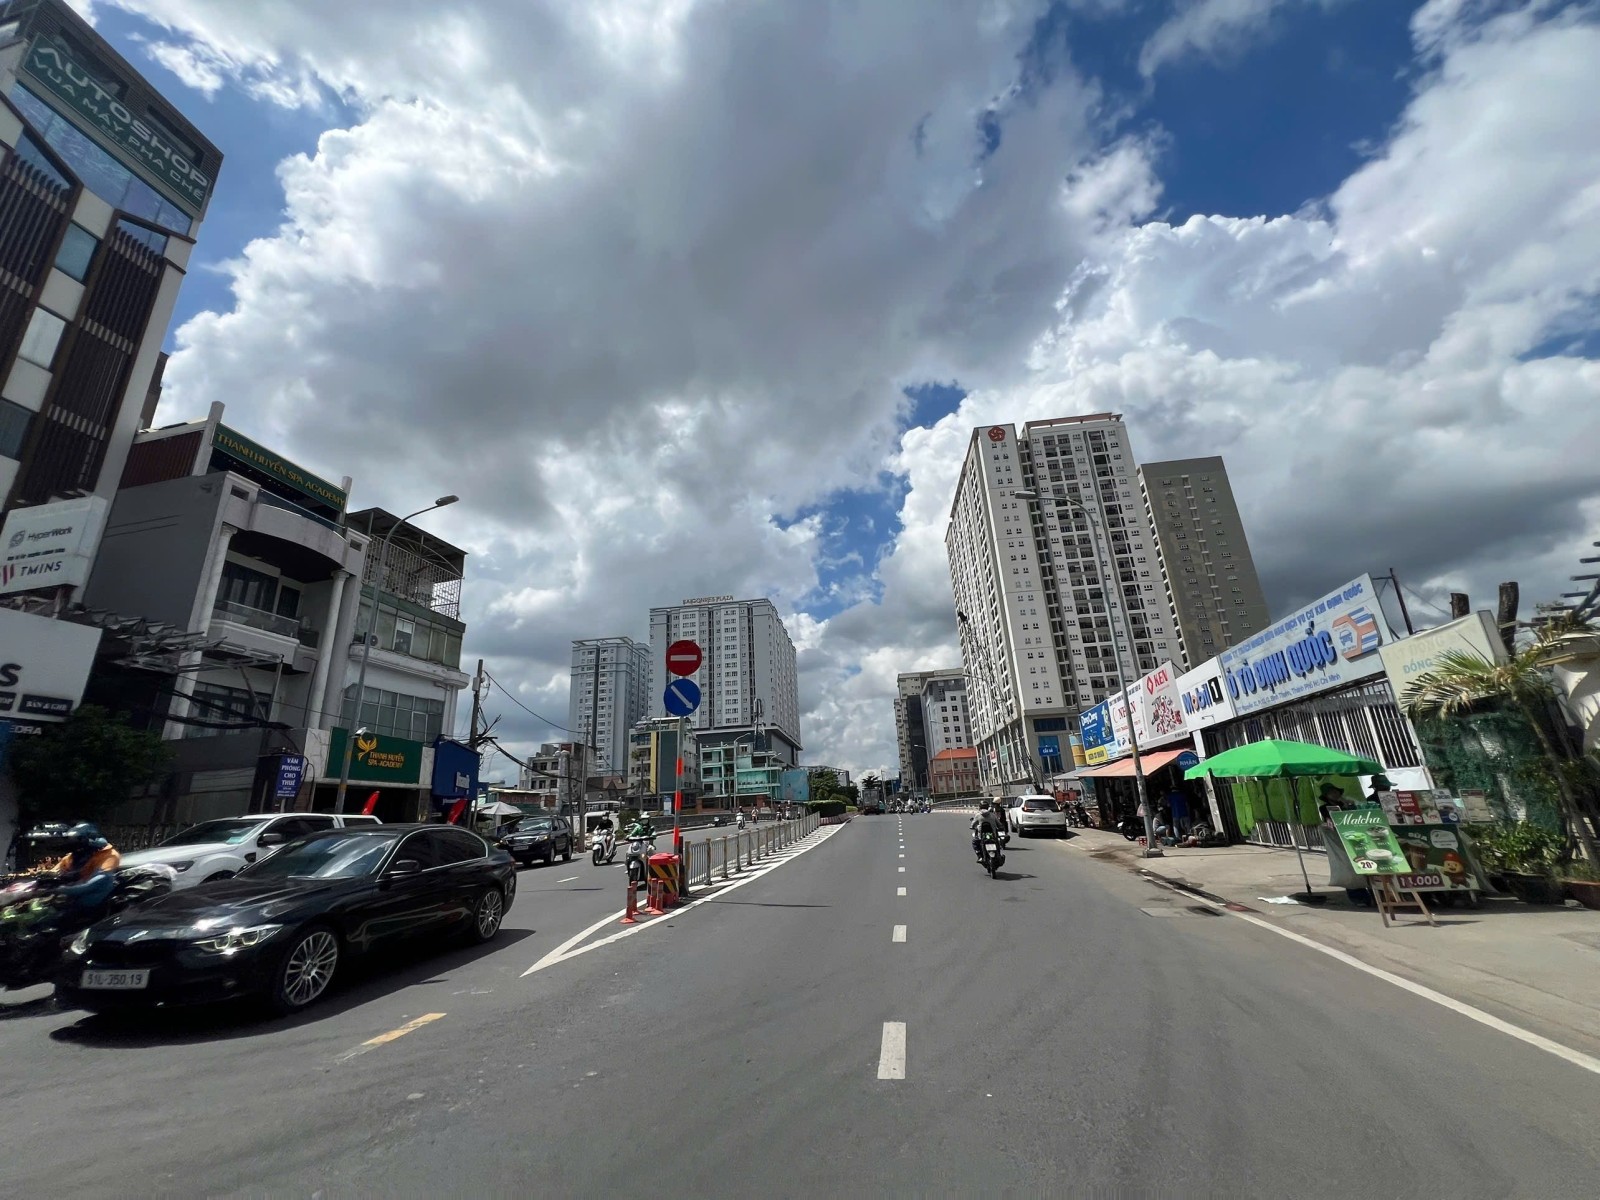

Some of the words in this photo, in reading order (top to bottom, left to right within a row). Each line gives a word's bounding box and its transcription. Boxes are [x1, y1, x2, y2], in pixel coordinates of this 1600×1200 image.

[34, 55, 75, 96] VUA
[129, 135, 165, 170] PHA
[37, 47, 208, 187] AUTOSHOP
[218, 433, 254, 460] THANH
[287, 470, 304, 484] SPA
[305, 481, 346, 505] ACADEMY
[1153, 669, 1168, 687] KEN
[1253, 650, 1291, 693] ĐỊNH
[1118, 701, 1137, 720] NHN
[1182, 683, 1213, 715] Mobil
[1336, 811, 1381, 826] Matcha
